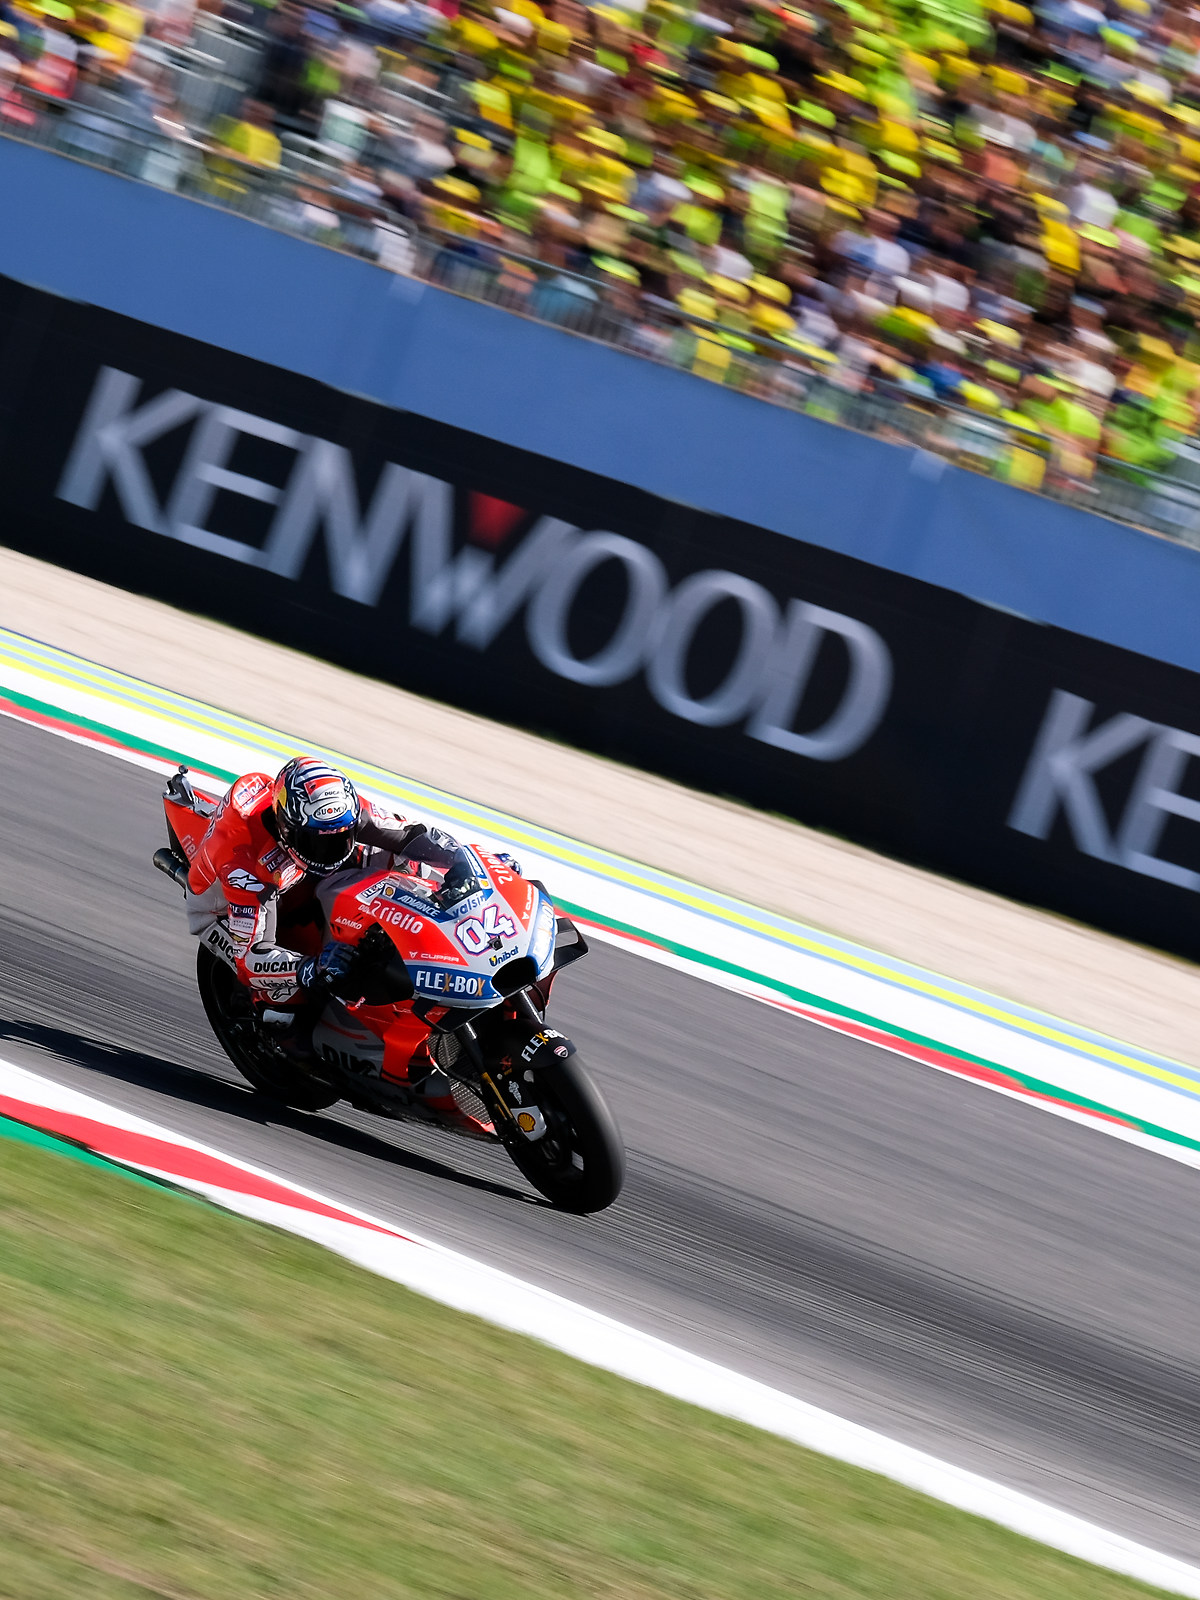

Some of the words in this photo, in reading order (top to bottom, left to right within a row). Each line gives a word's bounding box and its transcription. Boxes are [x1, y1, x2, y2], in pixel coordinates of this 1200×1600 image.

[58, 365, 893, 761] KENWOOD
[181, 834, 199, 864] riel
[380, 906, 424, 934] riello
[397, 895, 441, 918] ADVANCE
[454, 902, 518, 957] 04
[488, 945, 519, 967] Unibat
[415, 970, 486, 997] FLEX-BOX
